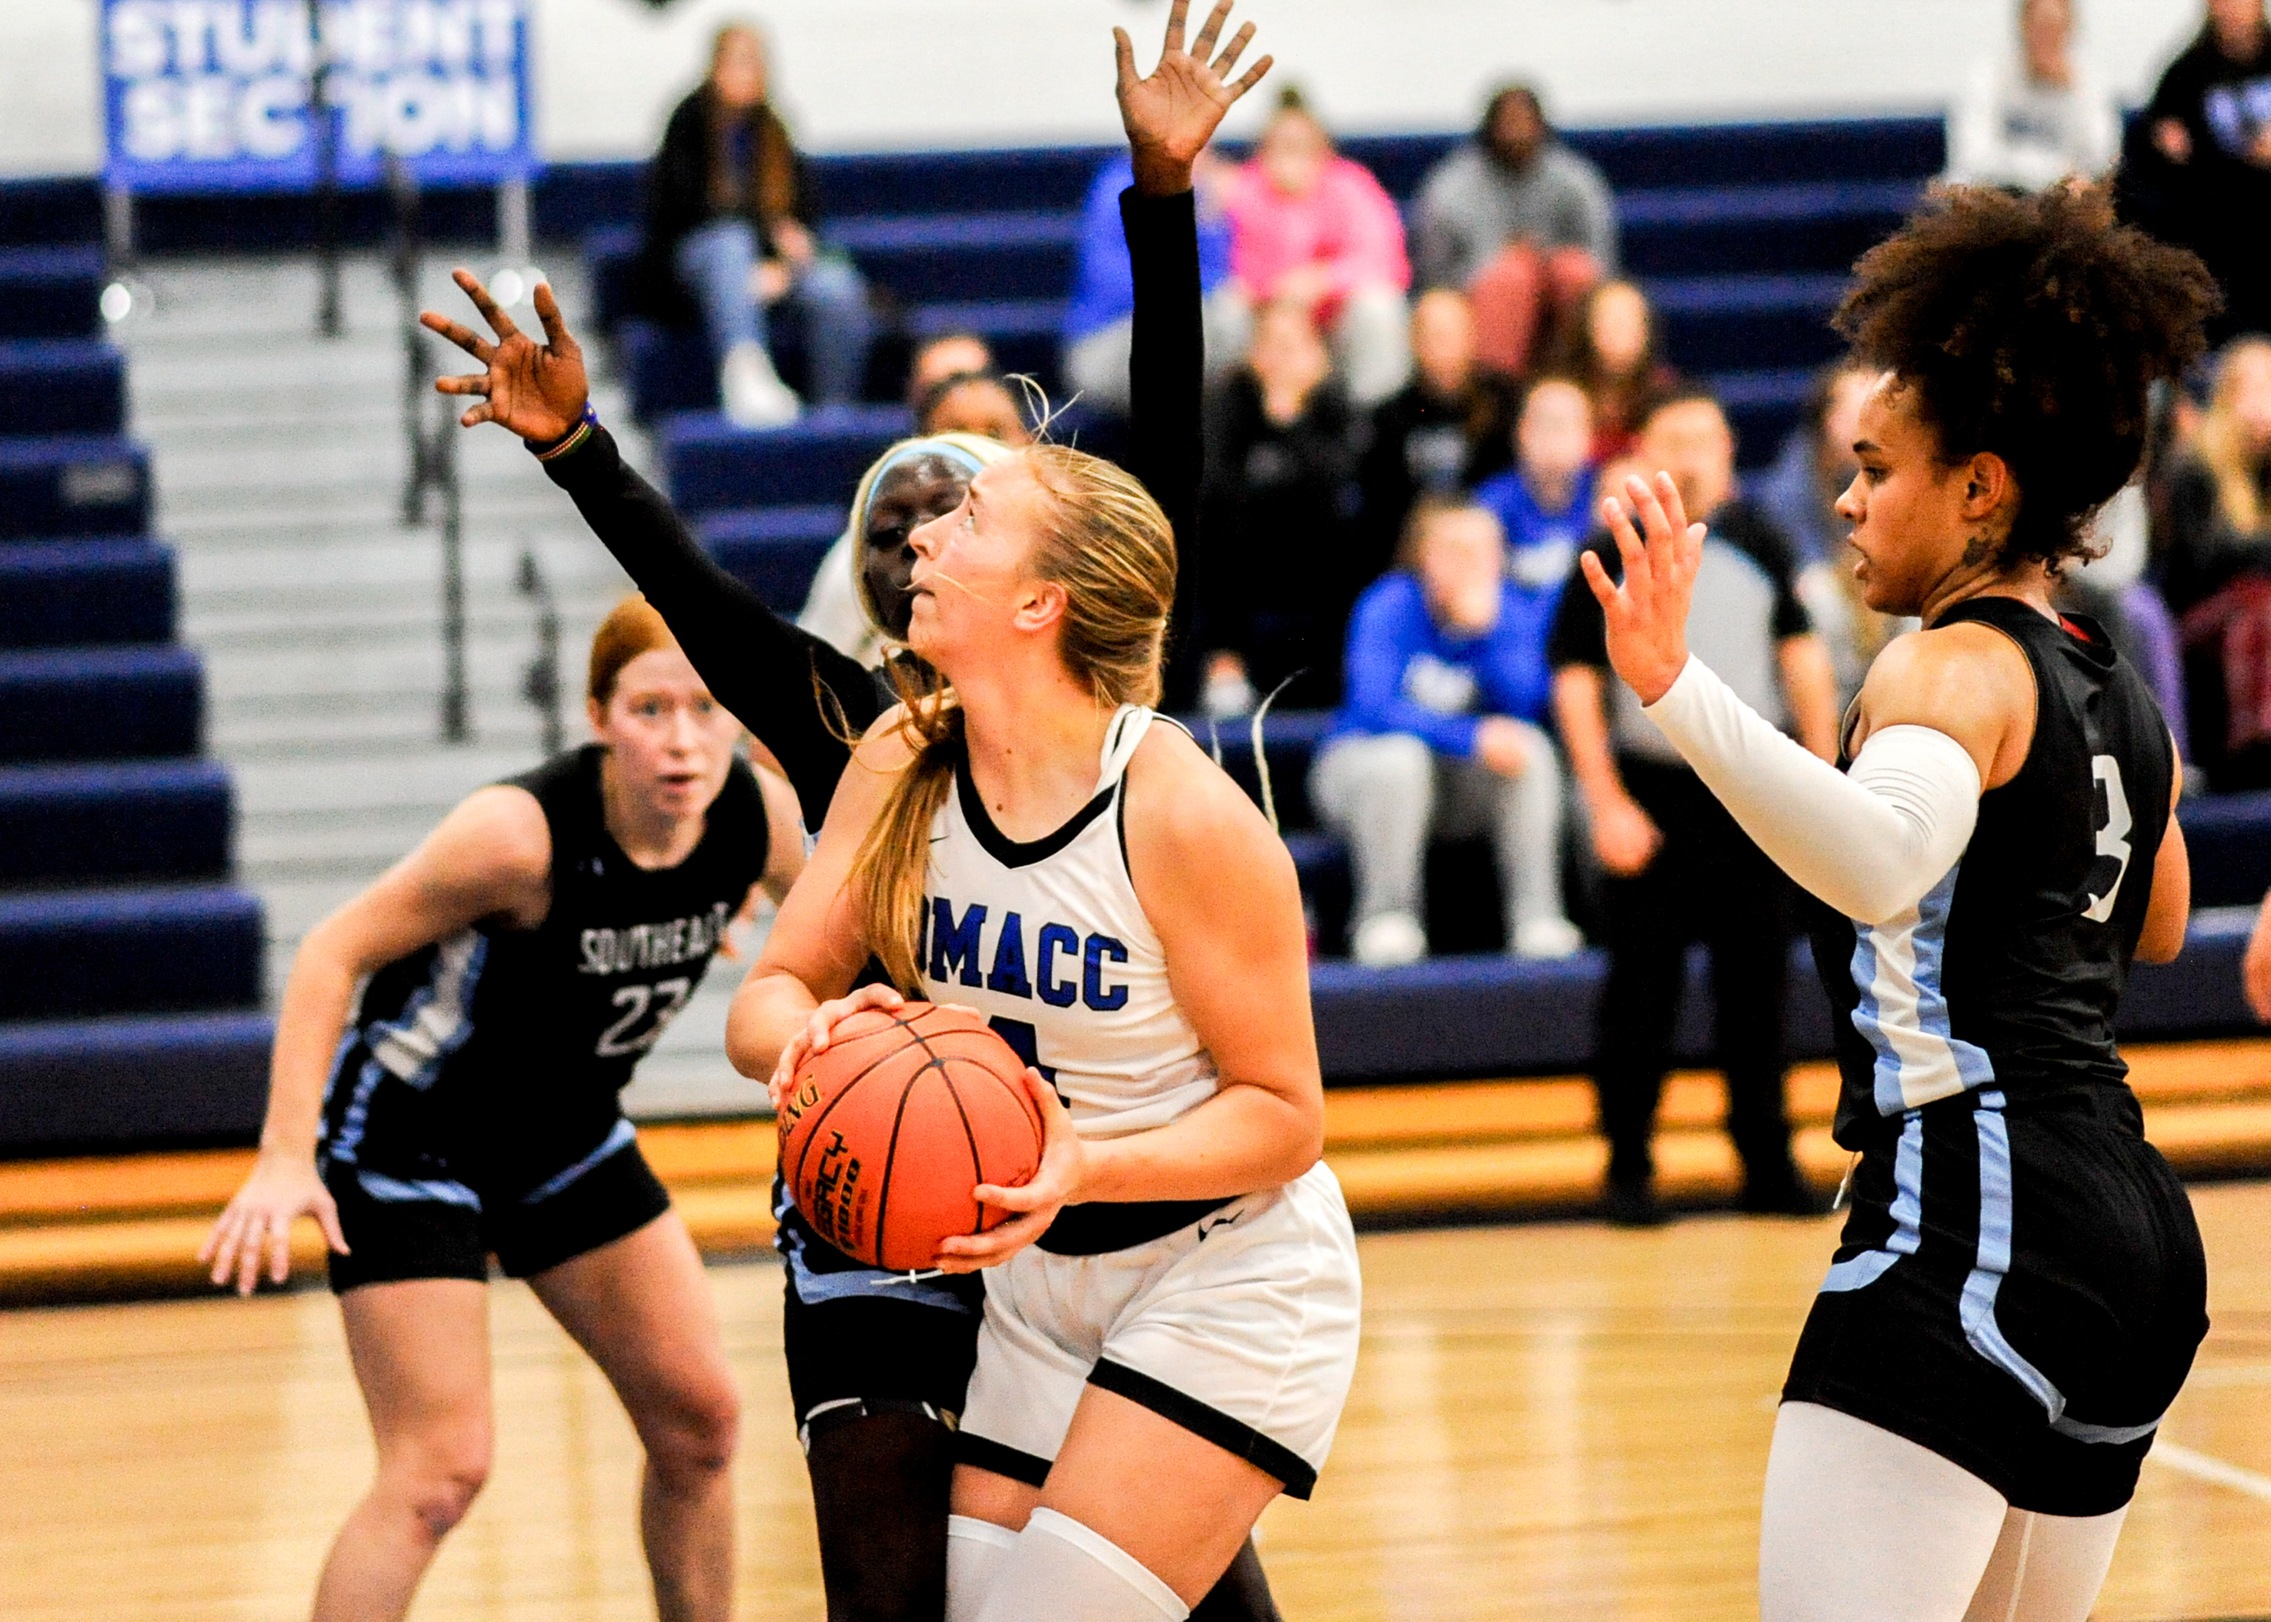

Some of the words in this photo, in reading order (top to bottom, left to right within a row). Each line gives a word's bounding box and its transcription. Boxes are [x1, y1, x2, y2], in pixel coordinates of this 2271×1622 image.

[2080, 754, 2133, 923] 3
[914, 893, 1128, 1011] MACC
[814, 1131, 849, 1240] EGACY
